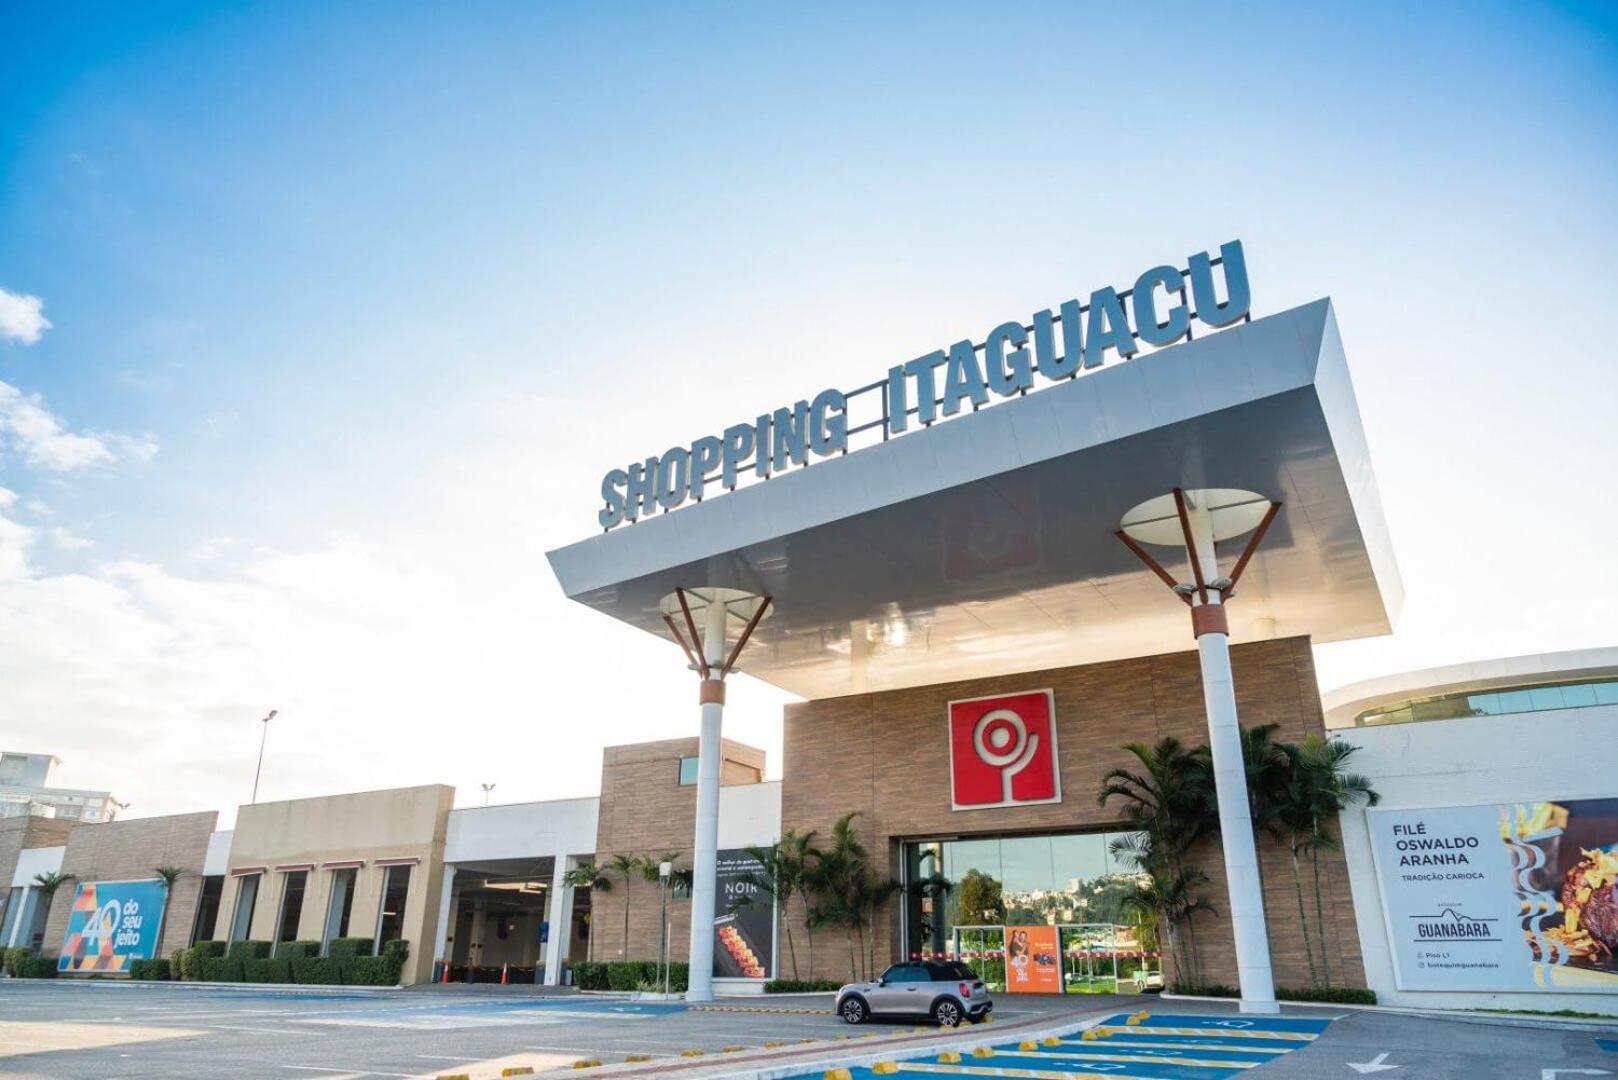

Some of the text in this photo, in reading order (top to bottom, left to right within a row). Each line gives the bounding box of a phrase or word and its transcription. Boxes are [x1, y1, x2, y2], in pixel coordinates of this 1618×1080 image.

[598, 238, 1251, 529] SHOPPING ITAGUACU
[1393, 821, 1427, 836] FILÉ
[1396, 836, 1480, 851] OSWALDO
[1399, 853, 1470, 867] ARANHA
[1401, 872, 1485, 882] TRADIÇÃO CARIOCA
[81, 898, 139, 946] 40 do
[122, 915, 143, 929] seu
[1417, 923, 1491, 938] GUANABARA
[113, 929, 140, 949] jeito
